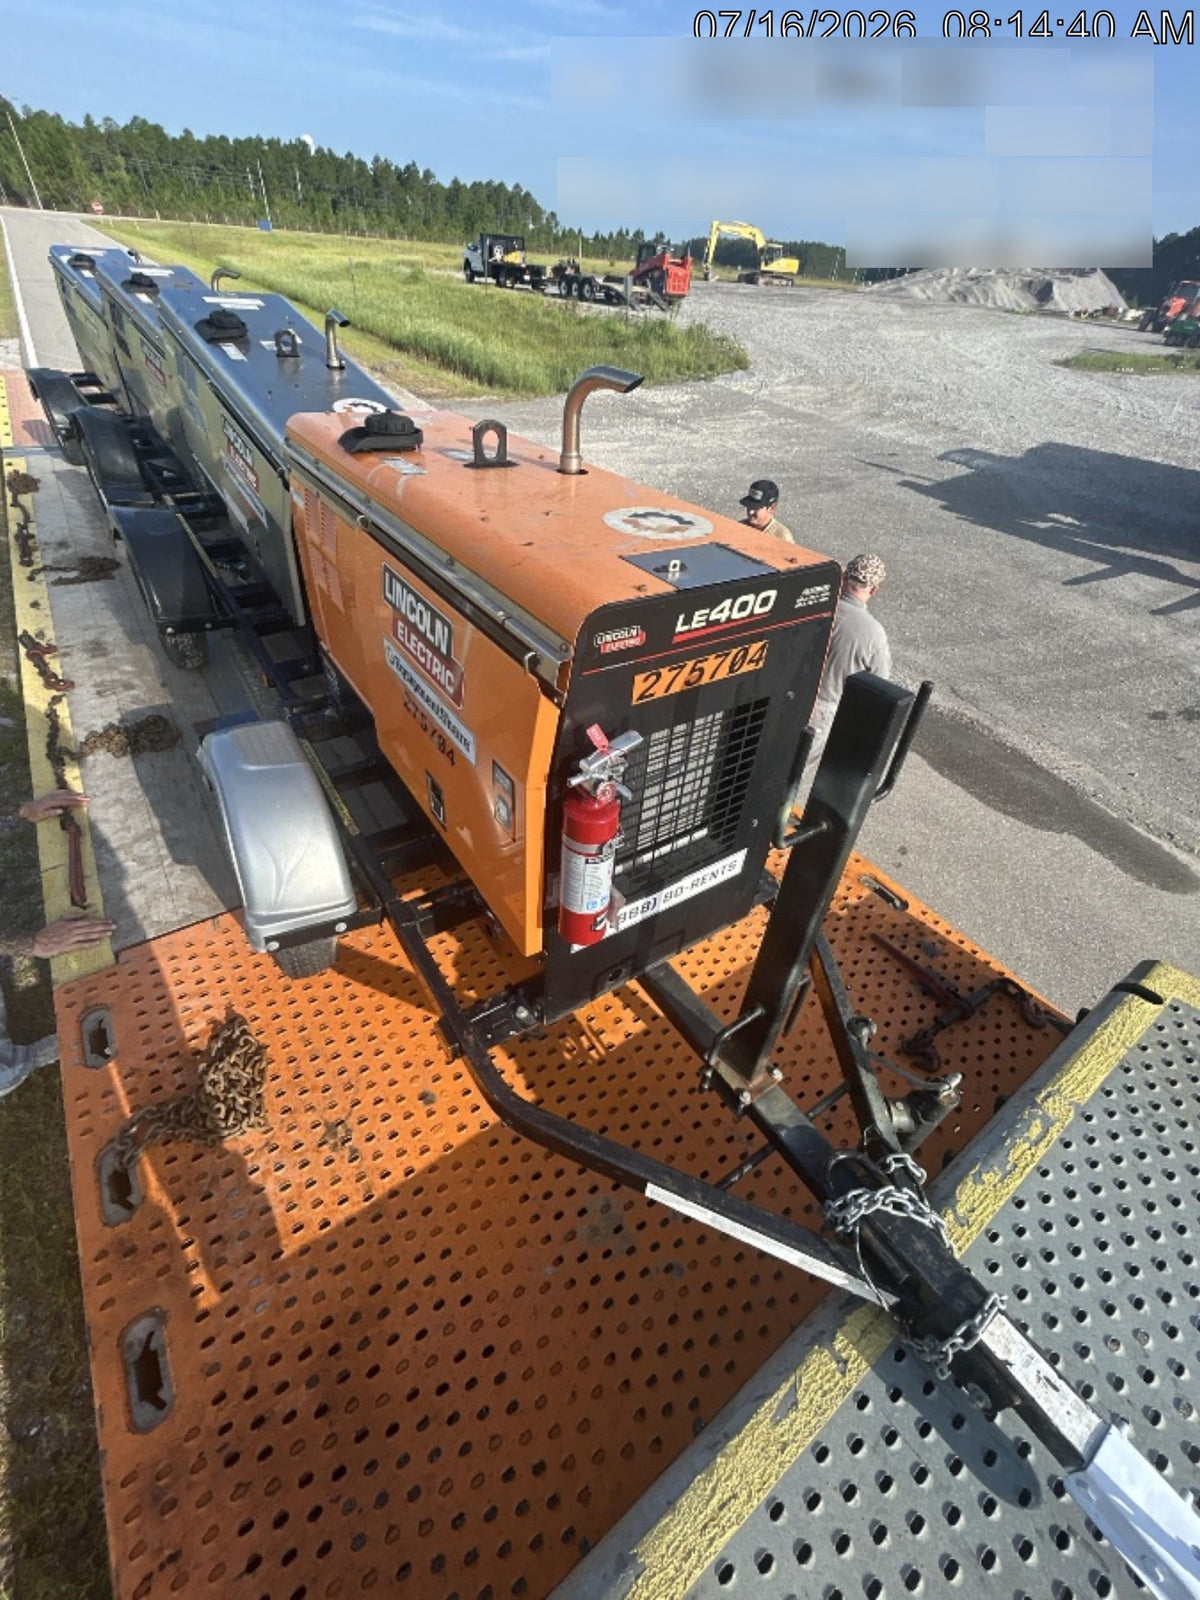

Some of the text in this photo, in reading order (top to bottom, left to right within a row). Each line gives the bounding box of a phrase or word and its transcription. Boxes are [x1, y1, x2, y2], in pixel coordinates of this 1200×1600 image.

[384, 571, 449, 657] LINCOLN
[675, 589, 778, 634] LE400
[396, 619, 455, 695] ELECTRIC
[636, 642, 767, 703] 275704
